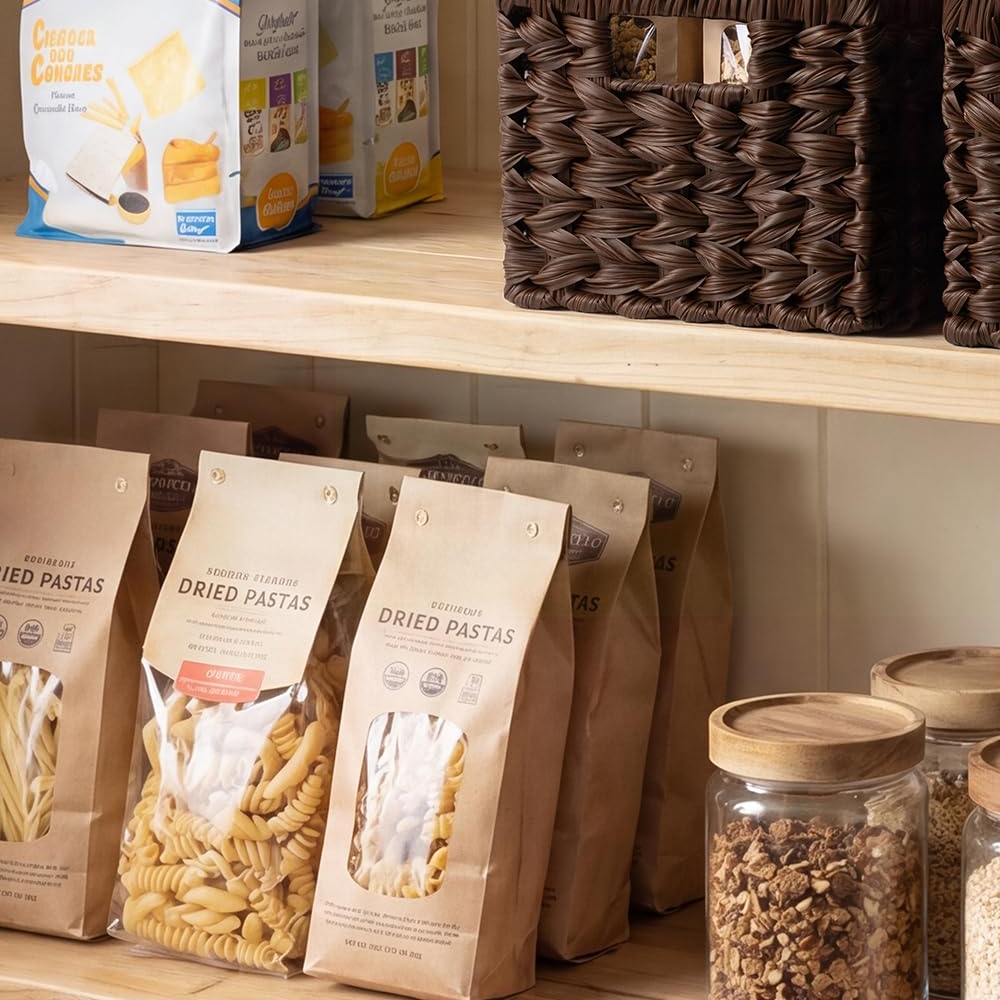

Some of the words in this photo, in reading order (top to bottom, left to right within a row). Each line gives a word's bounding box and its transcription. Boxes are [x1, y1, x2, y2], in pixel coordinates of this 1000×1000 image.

[0, 566, 35, 586] IED
[39, 571, 105, 594] PASTAS
[177, 577, 239, 603] DRIED
[243, 588, 313, 612] PASTAS
[378, 607, 440, 632] DRIED
[445, 619, 516, 646] PASTAS
